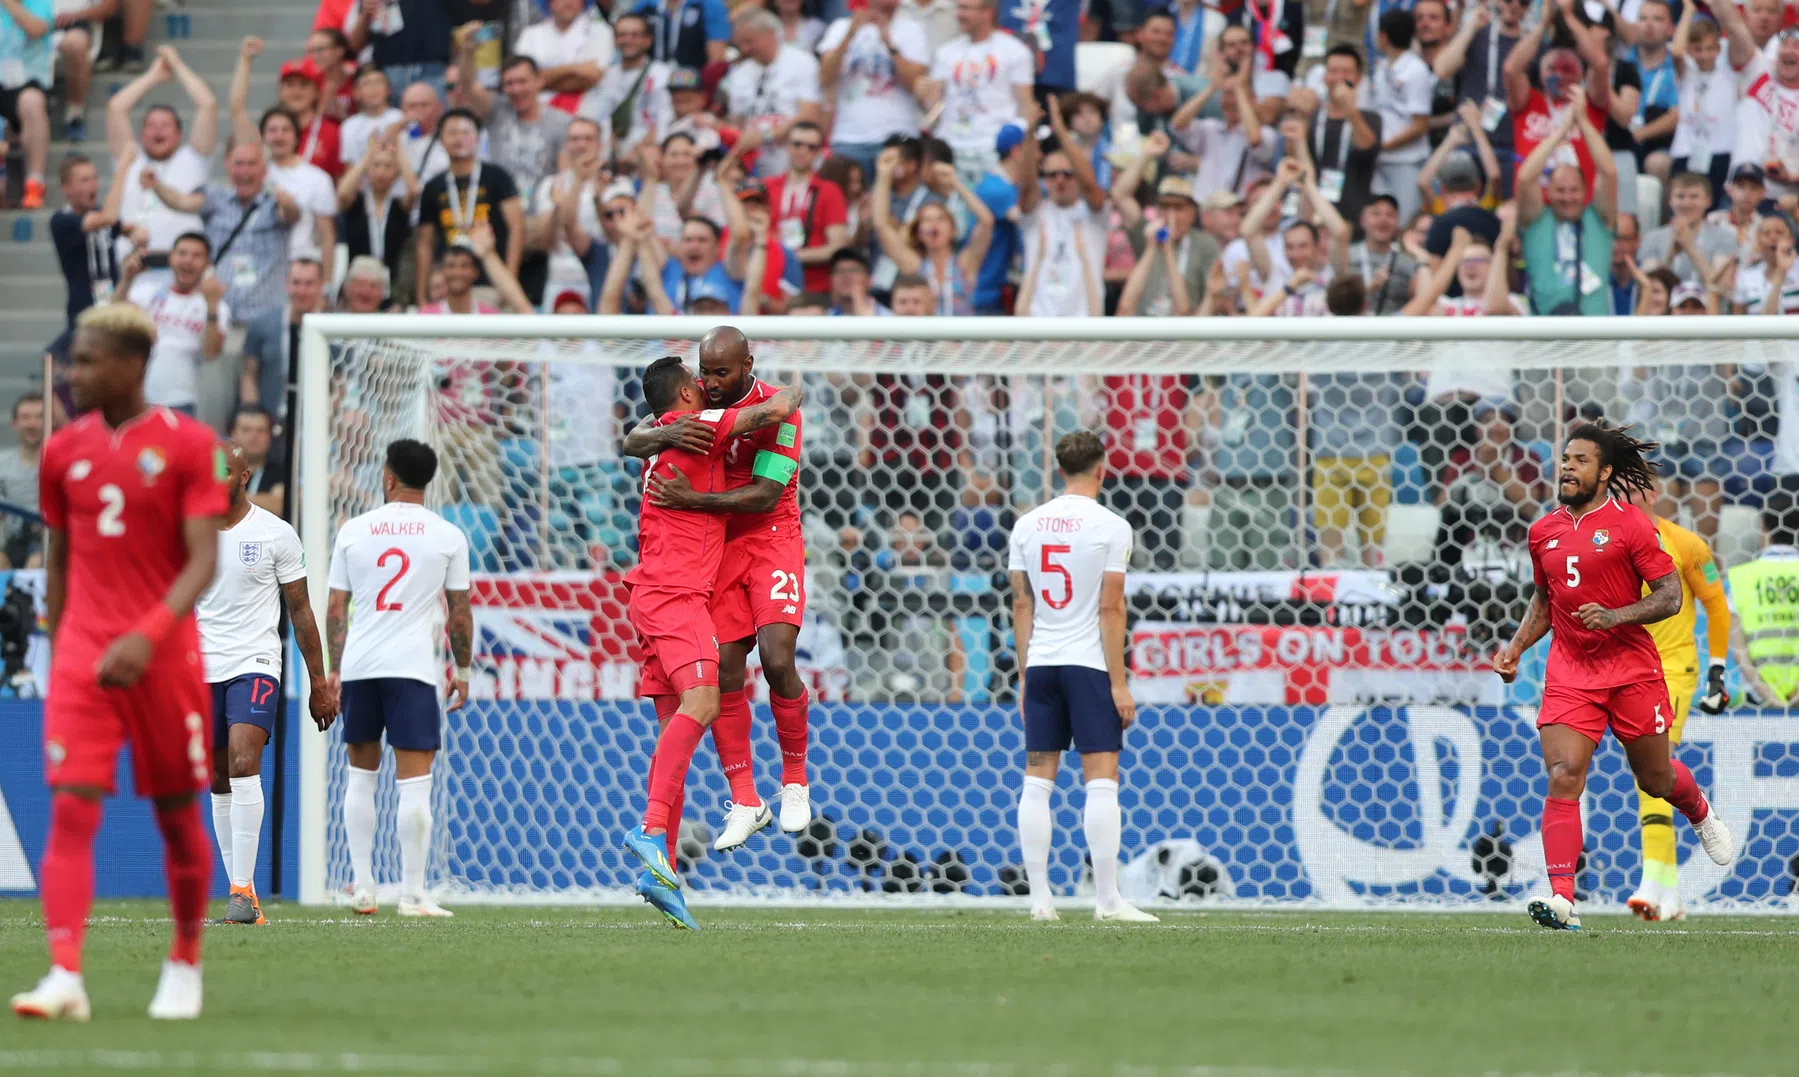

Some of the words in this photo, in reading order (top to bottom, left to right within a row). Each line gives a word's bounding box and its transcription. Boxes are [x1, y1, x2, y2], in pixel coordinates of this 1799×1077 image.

[97, 483, 126, 537] 2
[1036, 517, 1083, 533] STONES
[370, 522, 425, 536] WALKER
[376, 547, 410, 612] 2
[770, 569, 800, 603] 23
[1041, 544, 1073, 610] 5
[1566, 555, 1581, 588] 5
[1133, 632, 1262, 672] GIRLS
[1278, 630, 1344, 665] ON
[1364, 631, 1472, 666] TOU
[250, 677, 275, 705] 17
[1654, 702, 1666, 734] 5
